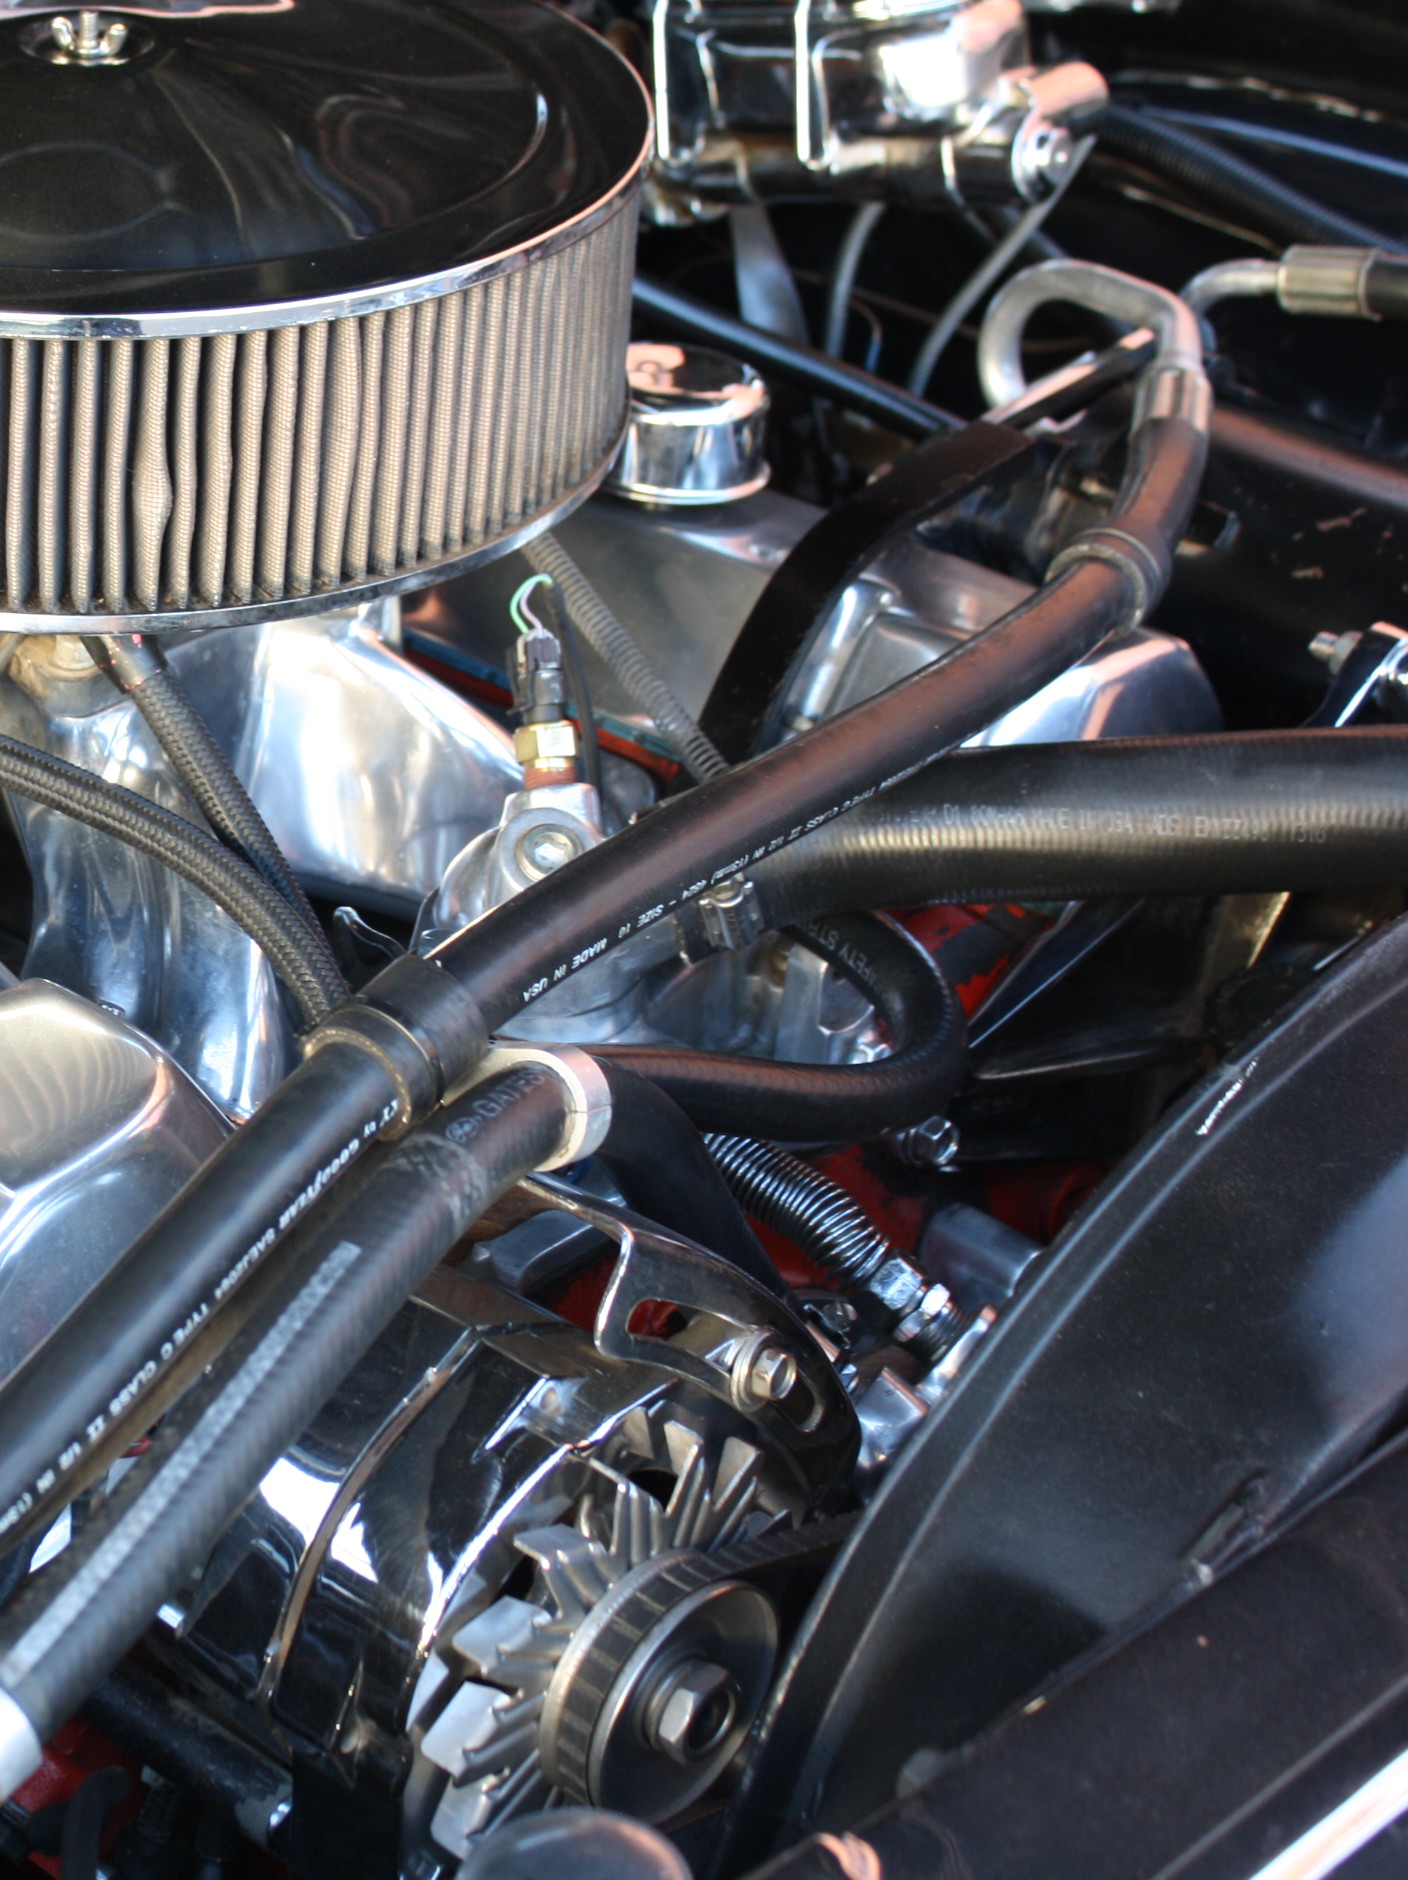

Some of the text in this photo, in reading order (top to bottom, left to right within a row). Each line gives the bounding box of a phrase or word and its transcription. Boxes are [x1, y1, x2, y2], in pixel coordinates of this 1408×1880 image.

[636, 904, 664, 927] SIZE
[570, 938, 608, 969] MADE
[523, 977, 549, 1002] USA
[553, 963, 567, 982] IN
[472, 1067, 545, 1117] GATES
[279, 1138, 360, 1229] GOODYEAR
[173, 1303, 209, 1345] TYPE
[107, 1360, 156, 1416] CLASS
